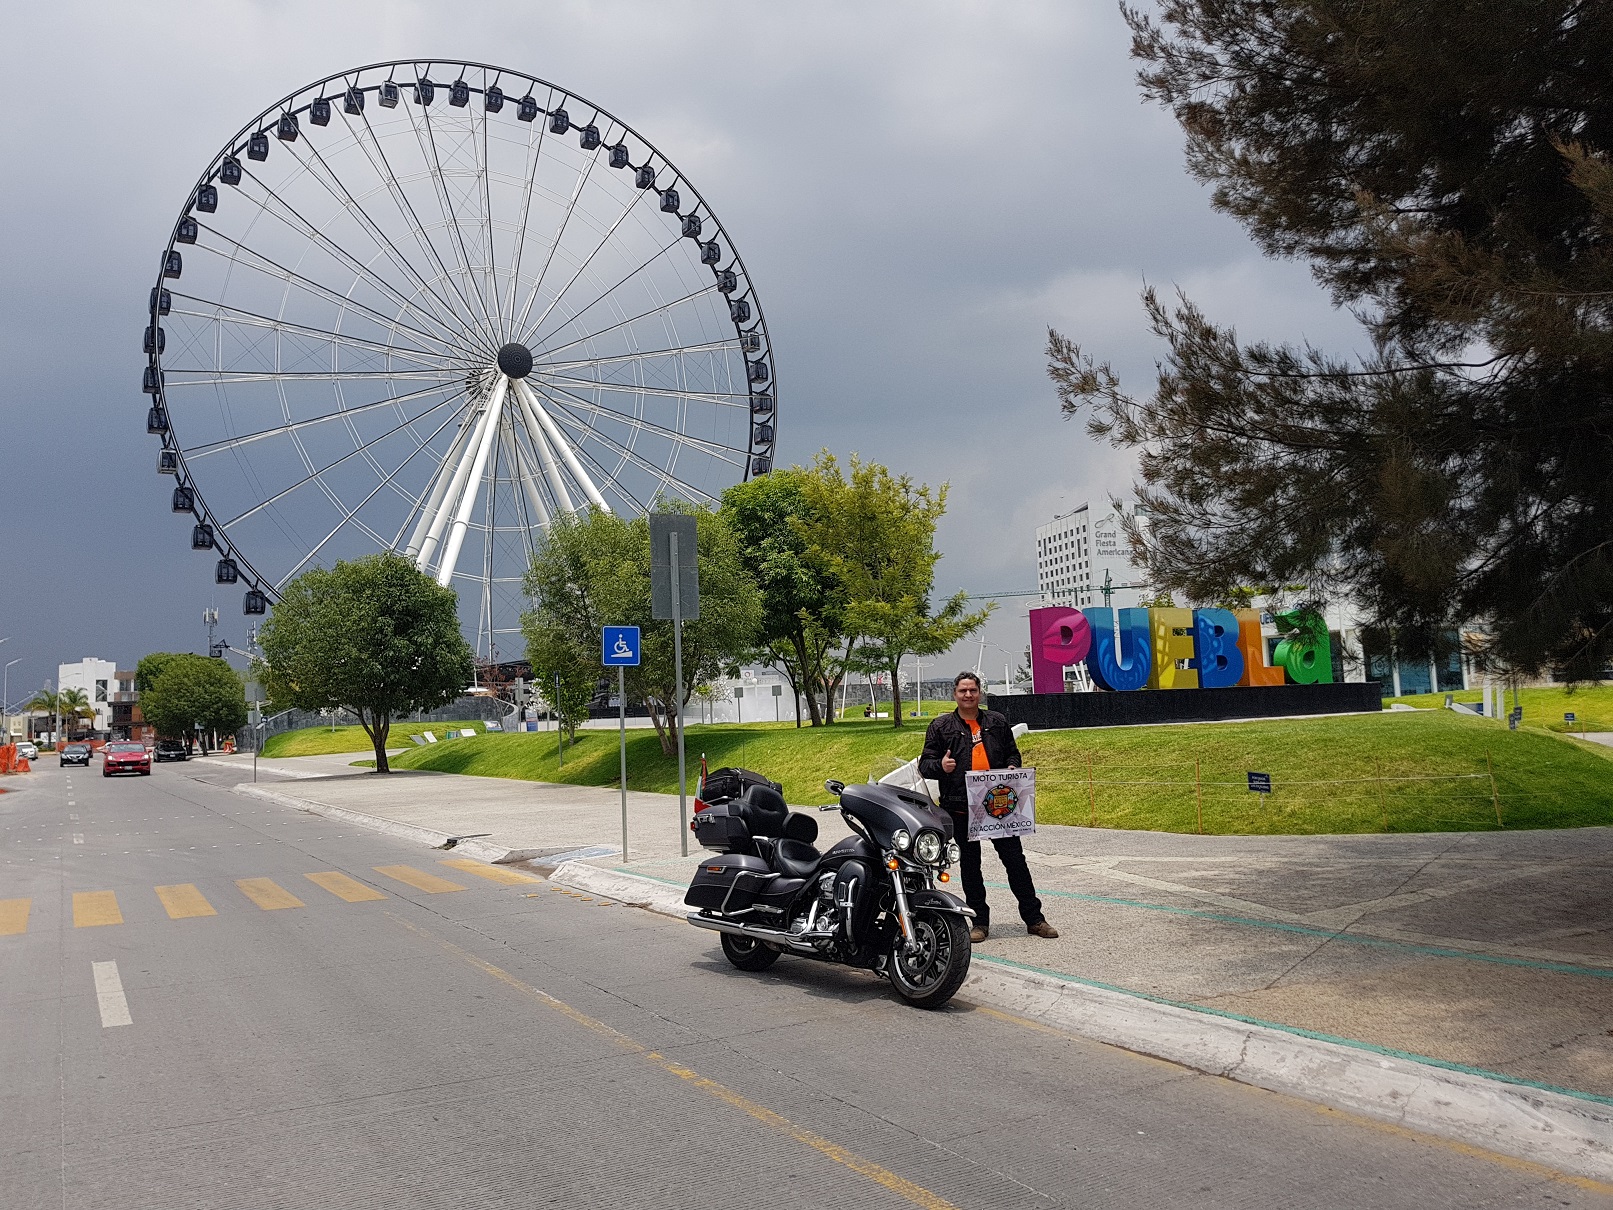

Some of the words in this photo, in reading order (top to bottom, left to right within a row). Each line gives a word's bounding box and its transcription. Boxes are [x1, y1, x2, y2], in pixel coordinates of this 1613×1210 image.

[1095, 530, 1116, 538] Grand
[972, 774, 997, 782] MOTO
[998, 772, 1028, 781] TURISTA
[980, 823, 1006, 832] ACCIÓN
[1006, 820, 1032, 829] MÉXICO
